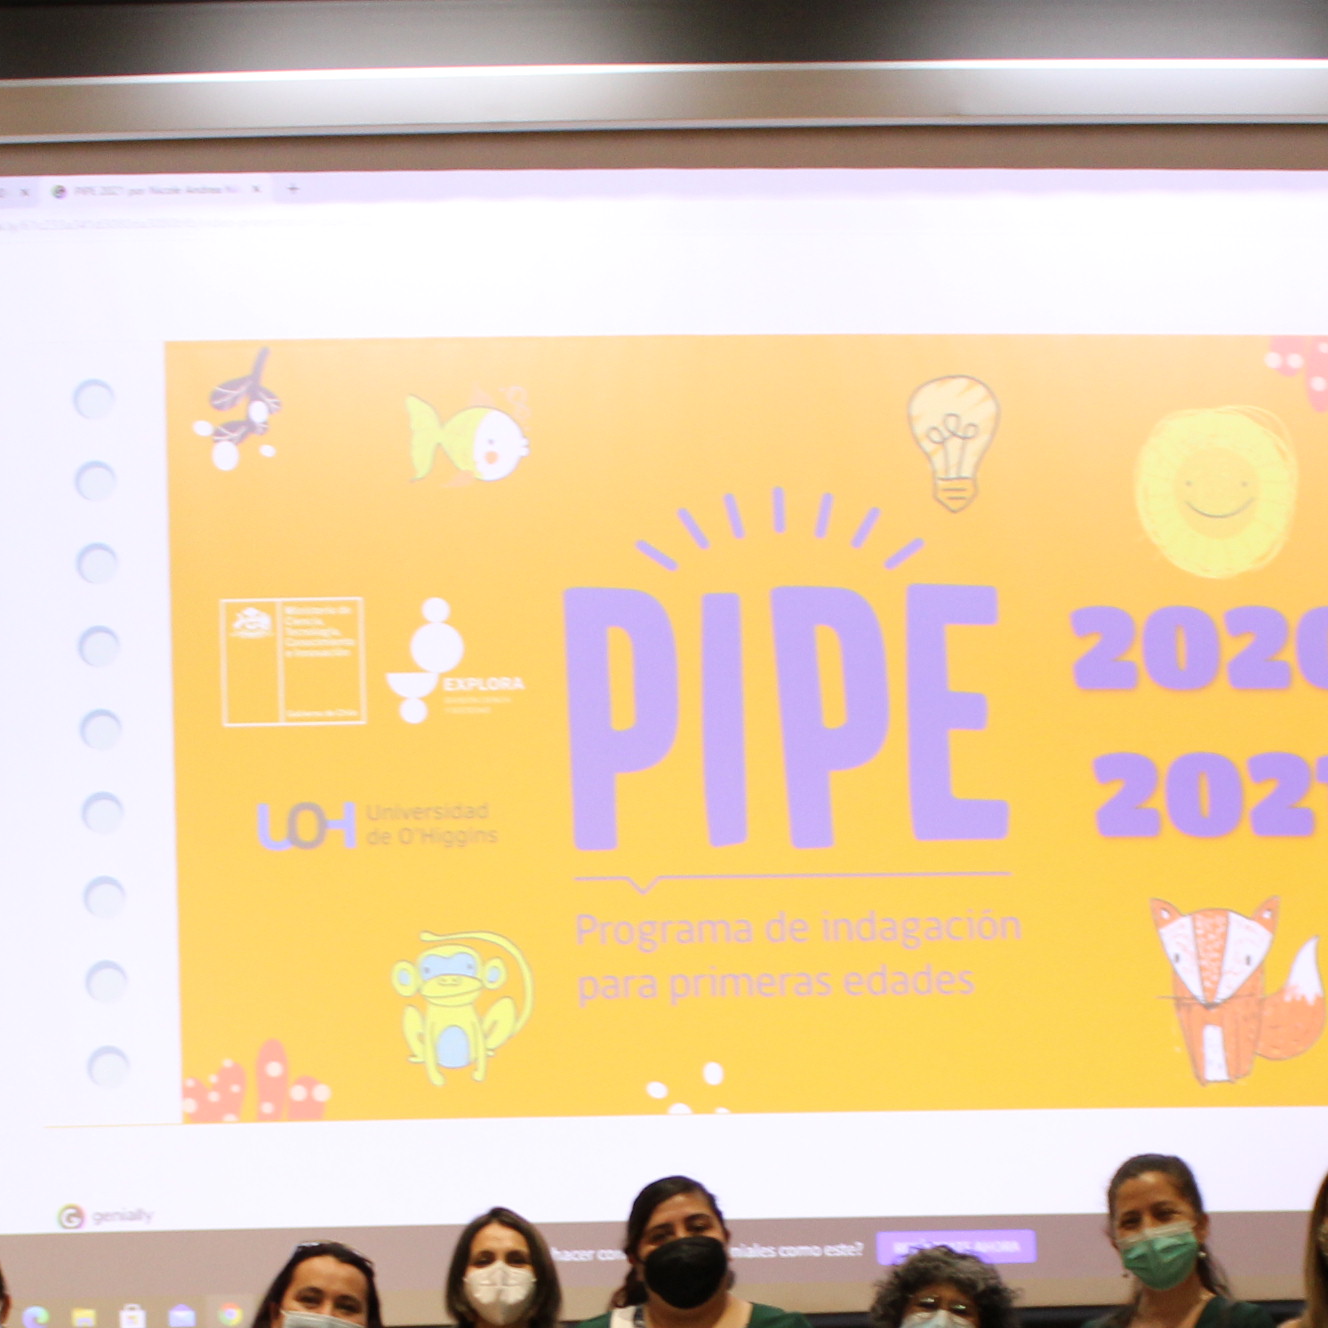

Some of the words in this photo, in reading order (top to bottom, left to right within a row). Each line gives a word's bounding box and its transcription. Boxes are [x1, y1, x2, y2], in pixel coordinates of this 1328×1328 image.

[442, 676, 526, 692] EXPLORA
[563, 583, 1011, 852] PIPE
[366, 802, 490, 821] Universidad
[366, 827, 392, 845] de
[575, 912, 755, 954] Programa
[765, 910, 810, 944] de
[821, 908, 1023, 951] indagación
[578, 972, 659, 1009] para
[669, 965, 833, 1007] primeras
[842, 964, 976, 997] edades
[778, 1245, 823, 1258] como
[824, 1240, 865, 1258] este?
